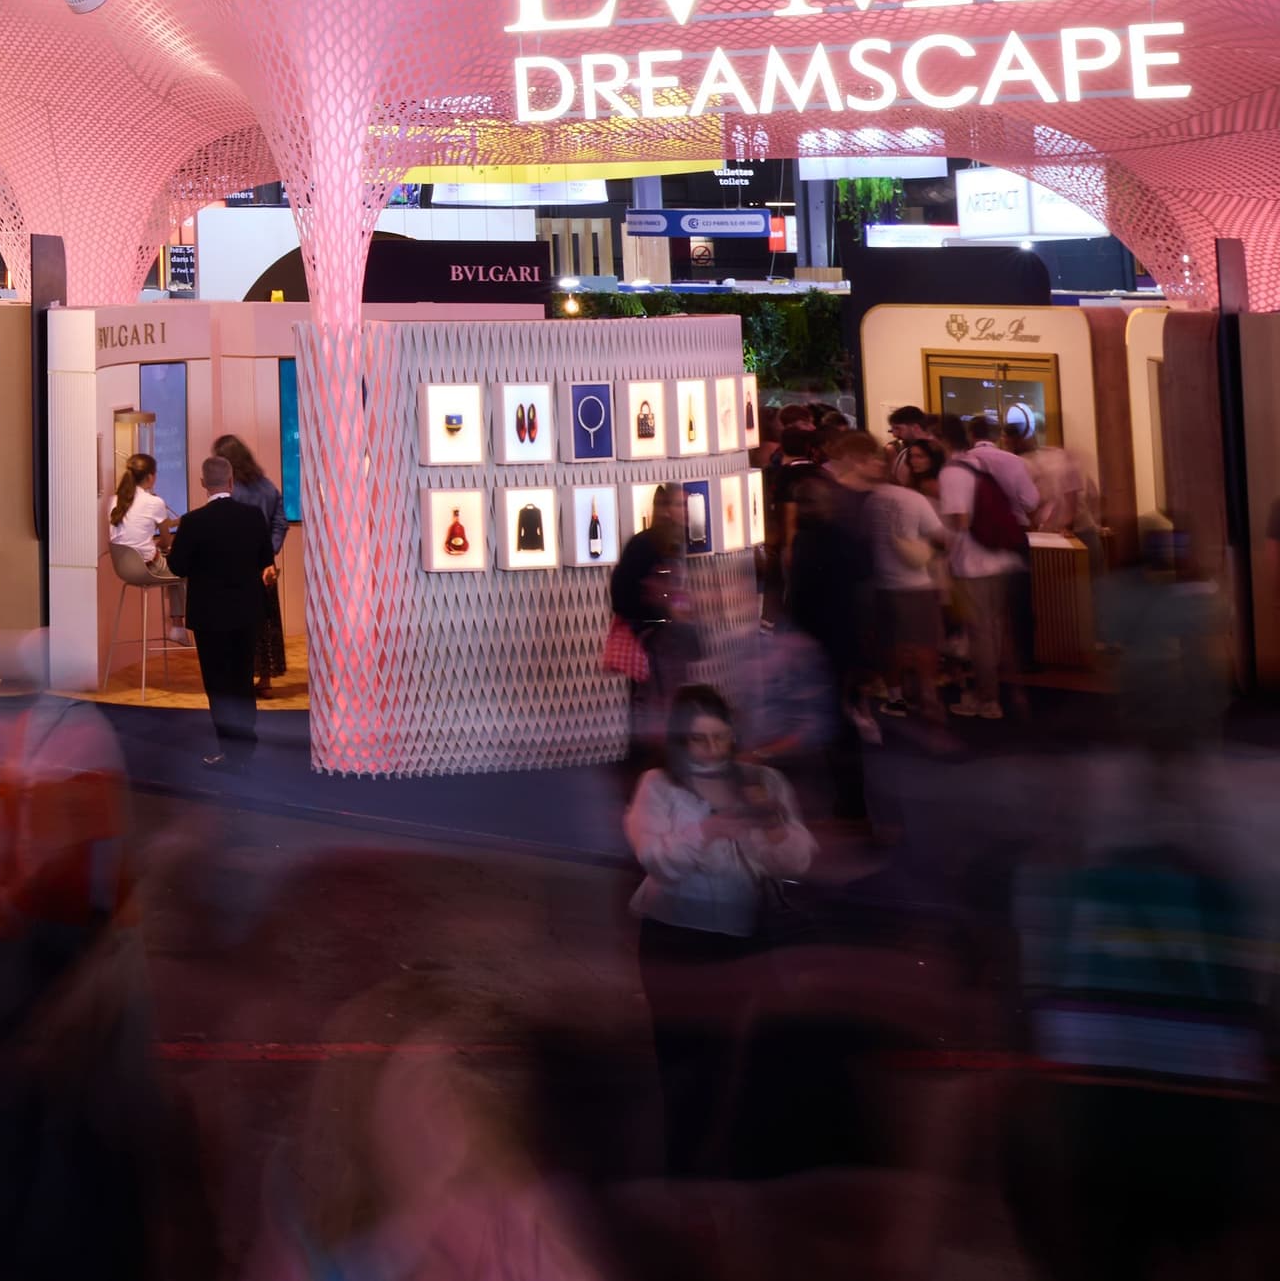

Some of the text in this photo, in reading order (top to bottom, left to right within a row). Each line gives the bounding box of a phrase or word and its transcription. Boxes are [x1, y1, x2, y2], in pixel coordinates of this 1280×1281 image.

[513, 21, 1192, 123] DREAMSCAPE
[713, 168, 754, 176] toilettes
[719, 178, 749, 186] toilets
[450, 265, 541, 283] BVLGARI
[96, 322, 166, 350] BVLGARI
